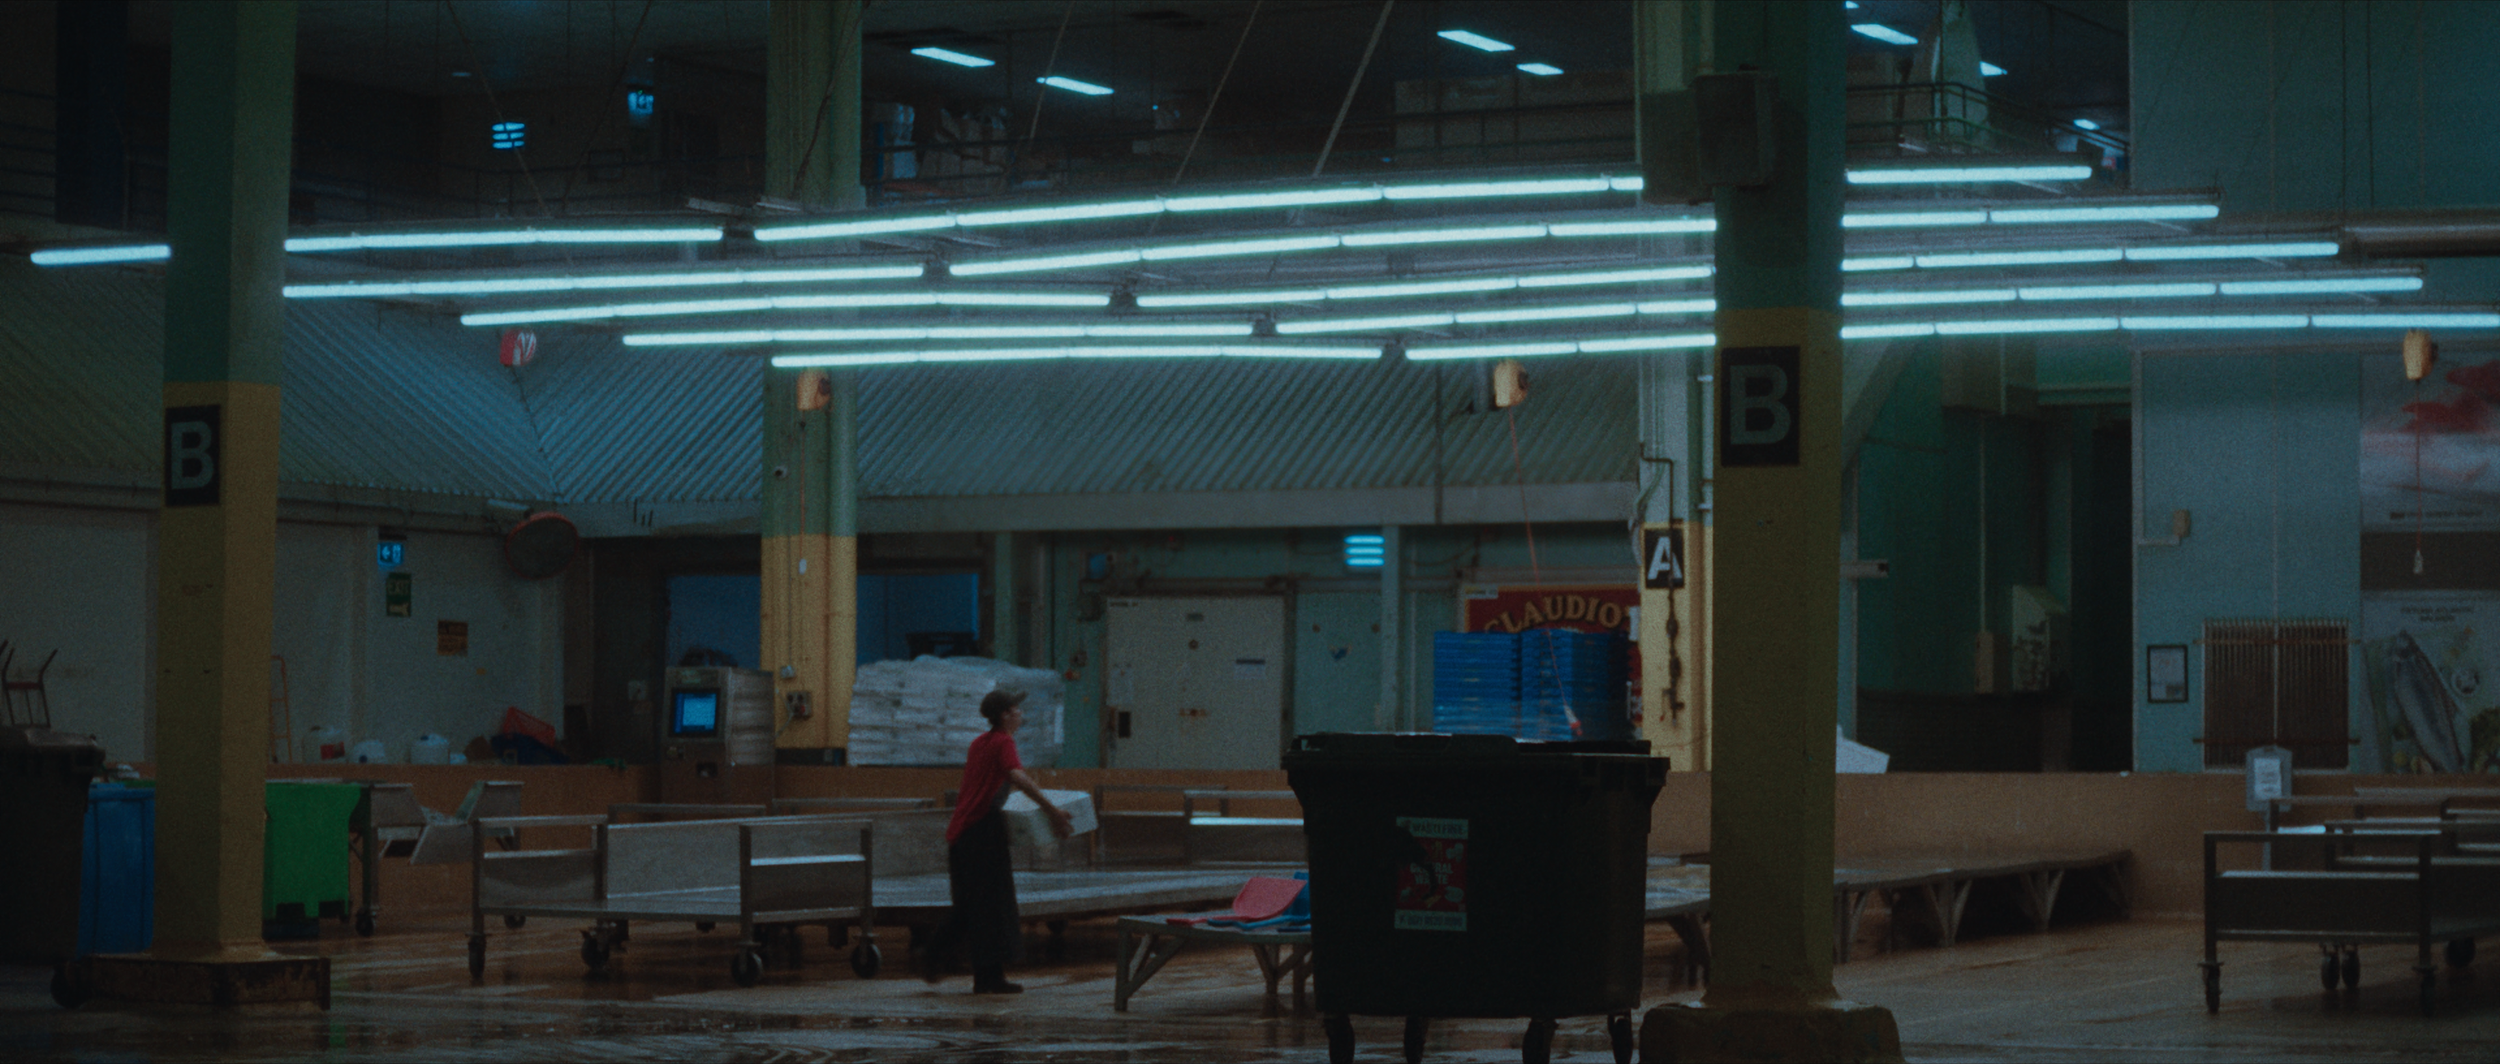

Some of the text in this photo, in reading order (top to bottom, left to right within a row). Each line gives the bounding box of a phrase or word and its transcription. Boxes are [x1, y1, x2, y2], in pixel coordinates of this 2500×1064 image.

[1730, 364, 1791, 445] B
[171, 420, 214, 490] B
[1647, 536, 1683, 580] A
